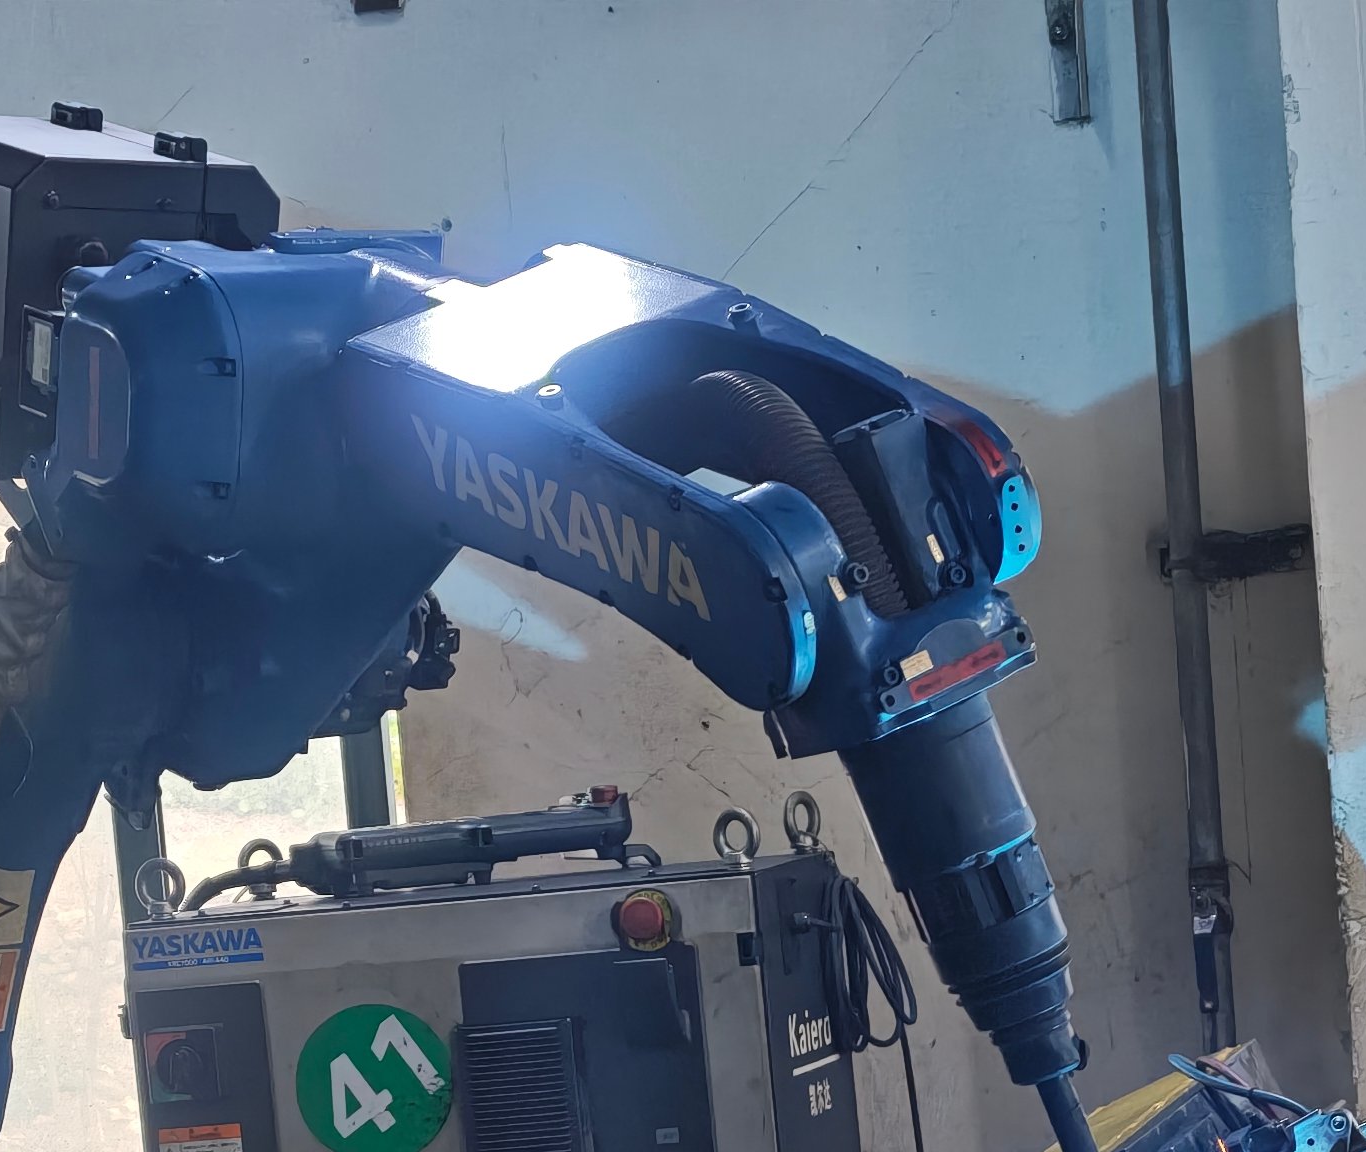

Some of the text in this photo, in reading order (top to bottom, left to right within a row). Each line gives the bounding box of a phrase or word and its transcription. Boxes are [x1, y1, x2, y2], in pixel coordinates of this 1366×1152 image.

[410, 413, 712, 622] YASKAWA
[131, 927, 263, 960] YASKAWA
[329, 1013, 446, 1139] 41
